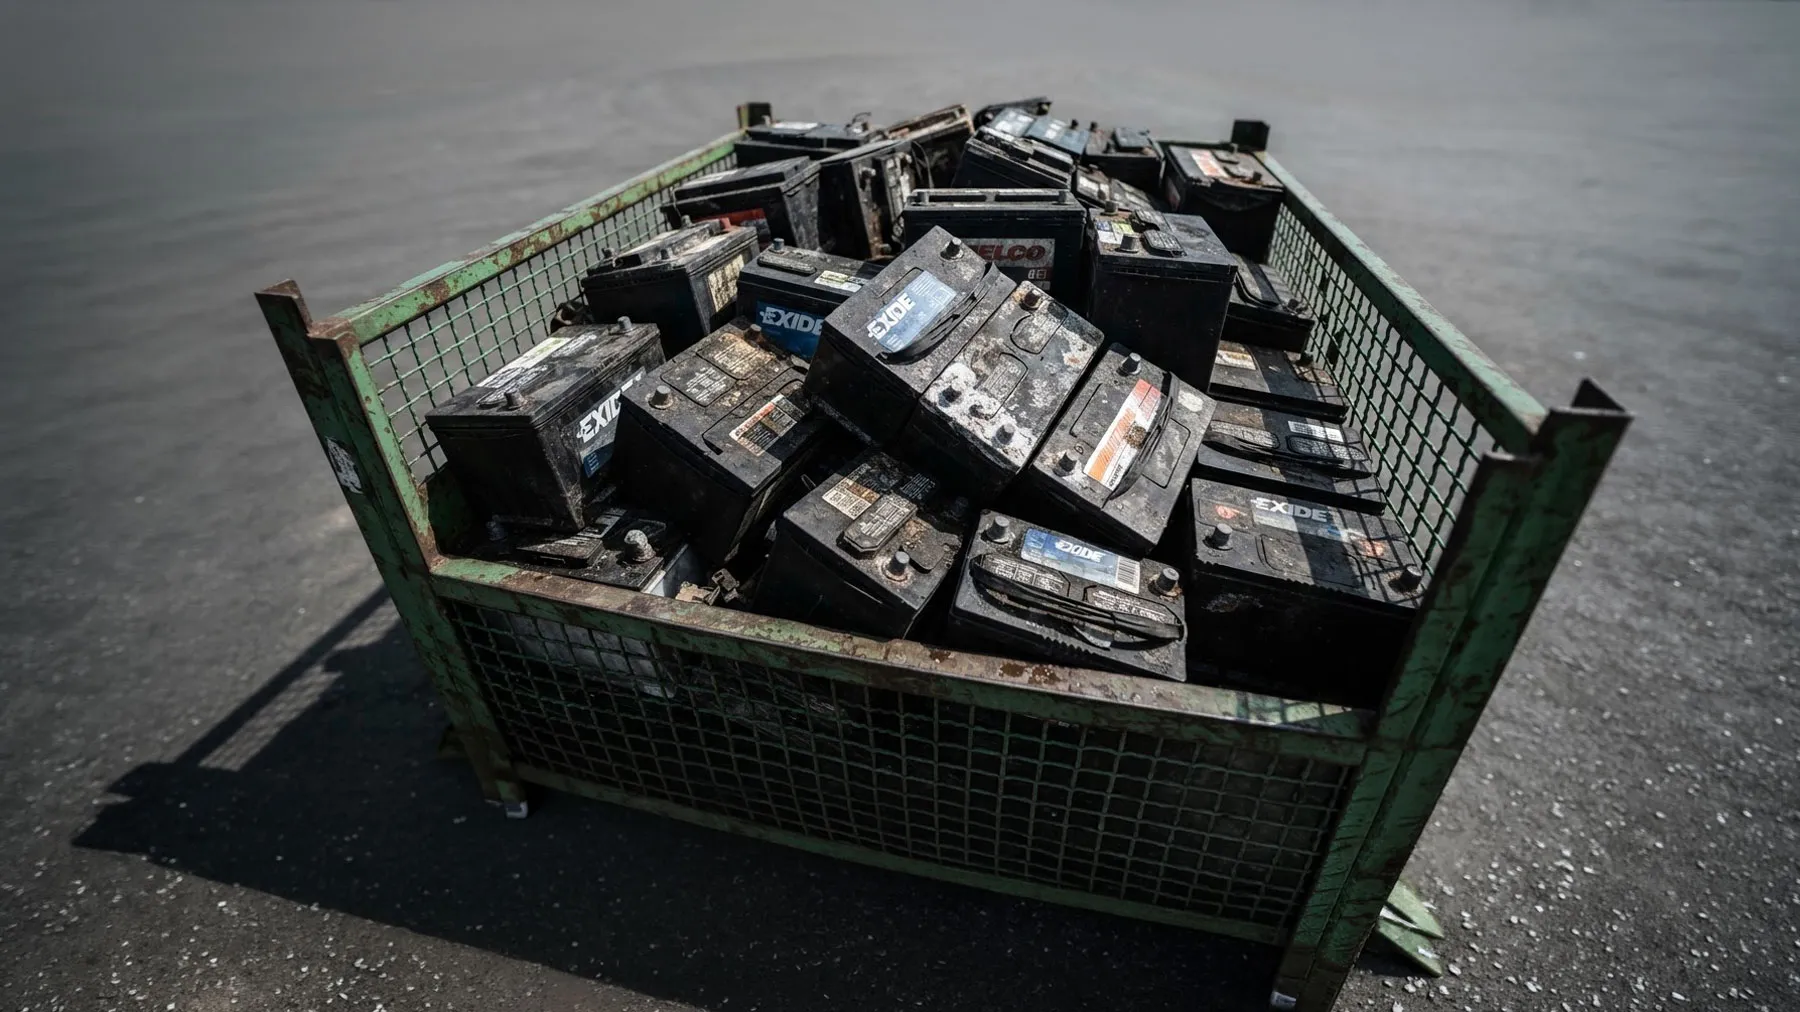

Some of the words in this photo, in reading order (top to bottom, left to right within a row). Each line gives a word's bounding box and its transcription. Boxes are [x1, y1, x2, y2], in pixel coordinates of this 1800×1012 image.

[968, 244, 1046, 262] ELCO
[866, 292, 916, 339] EXIDE
[1250, 497, 1328, 522] EXIDE
